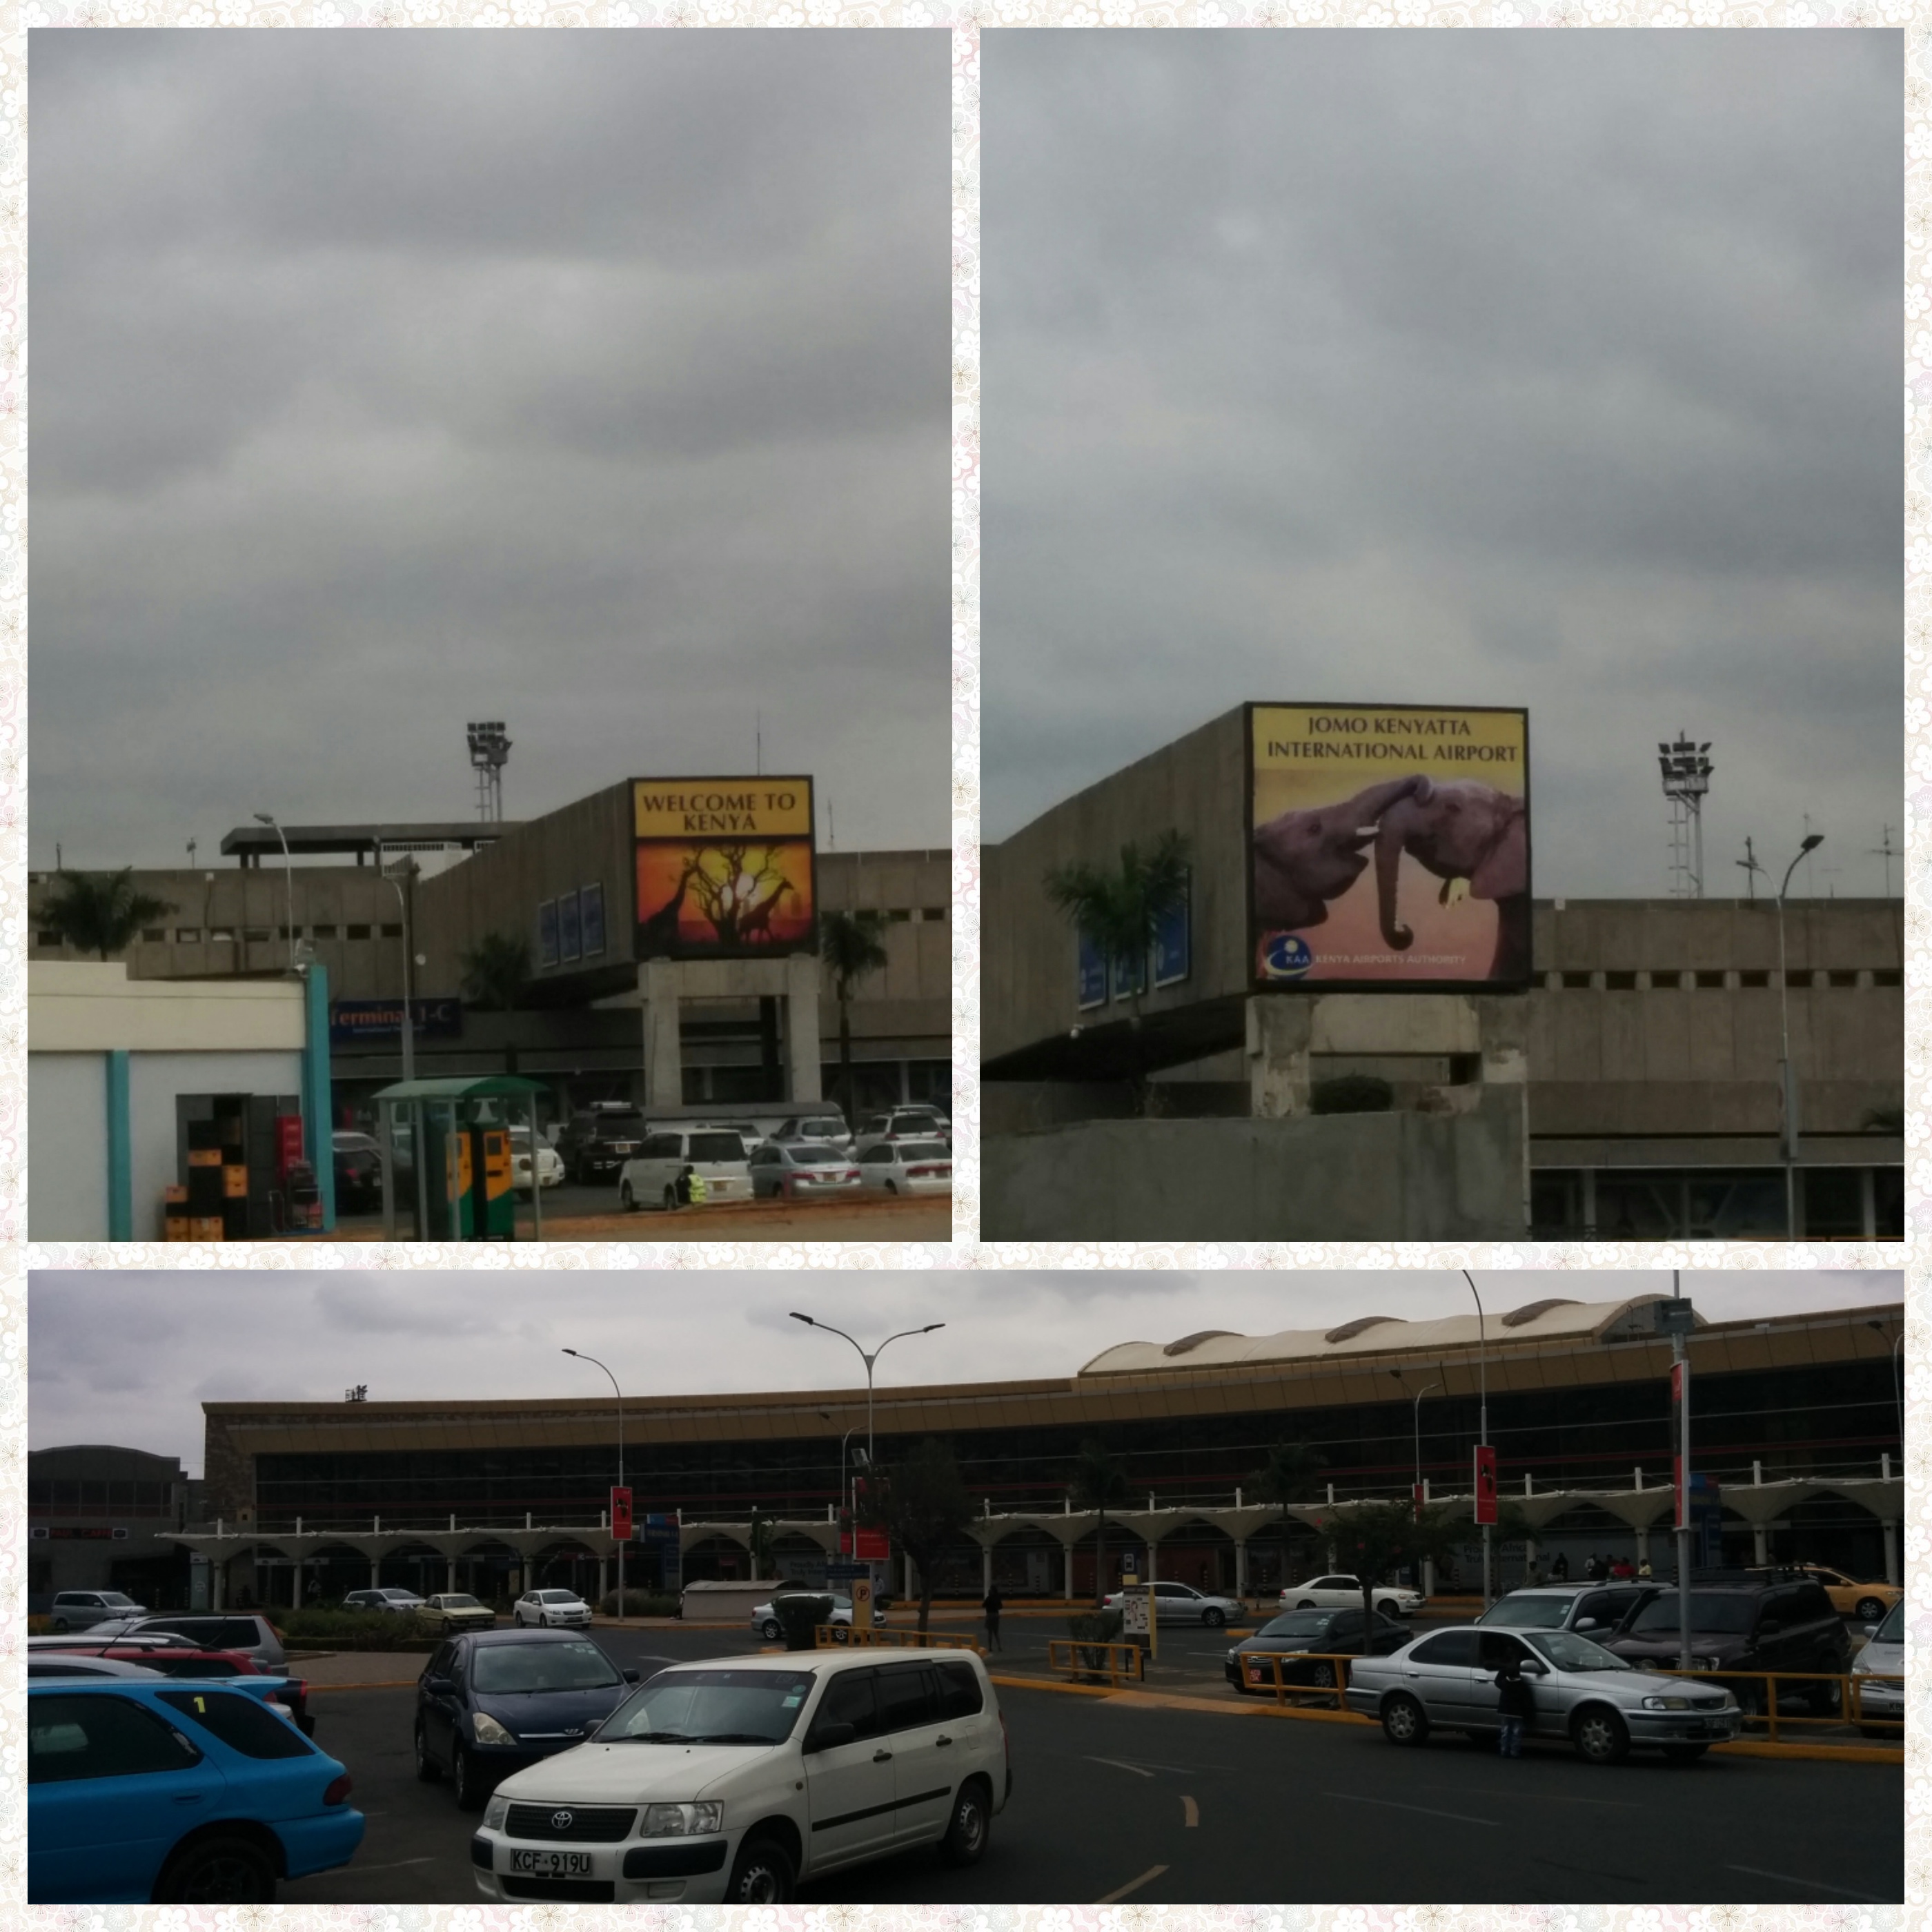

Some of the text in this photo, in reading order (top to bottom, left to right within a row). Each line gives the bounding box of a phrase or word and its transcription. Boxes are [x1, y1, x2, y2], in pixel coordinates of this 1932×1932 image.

[1309, 716, 1471, 736] JOMO KENYATTA
[1268, 741, 1518, 762] INTERNATIONAL AIRPORT
[643, 793, 796, 811] WELCOME TO
[683, 813, 757, 831] KENYA
[1285, 954, 1311, 965] KAA
[1315, 954, 1466, 965] KENYA AIRPORTS AUTHORITY
[331, 1005, 410, 1026] Termina
[193, 1696, 206, 1714] 1
